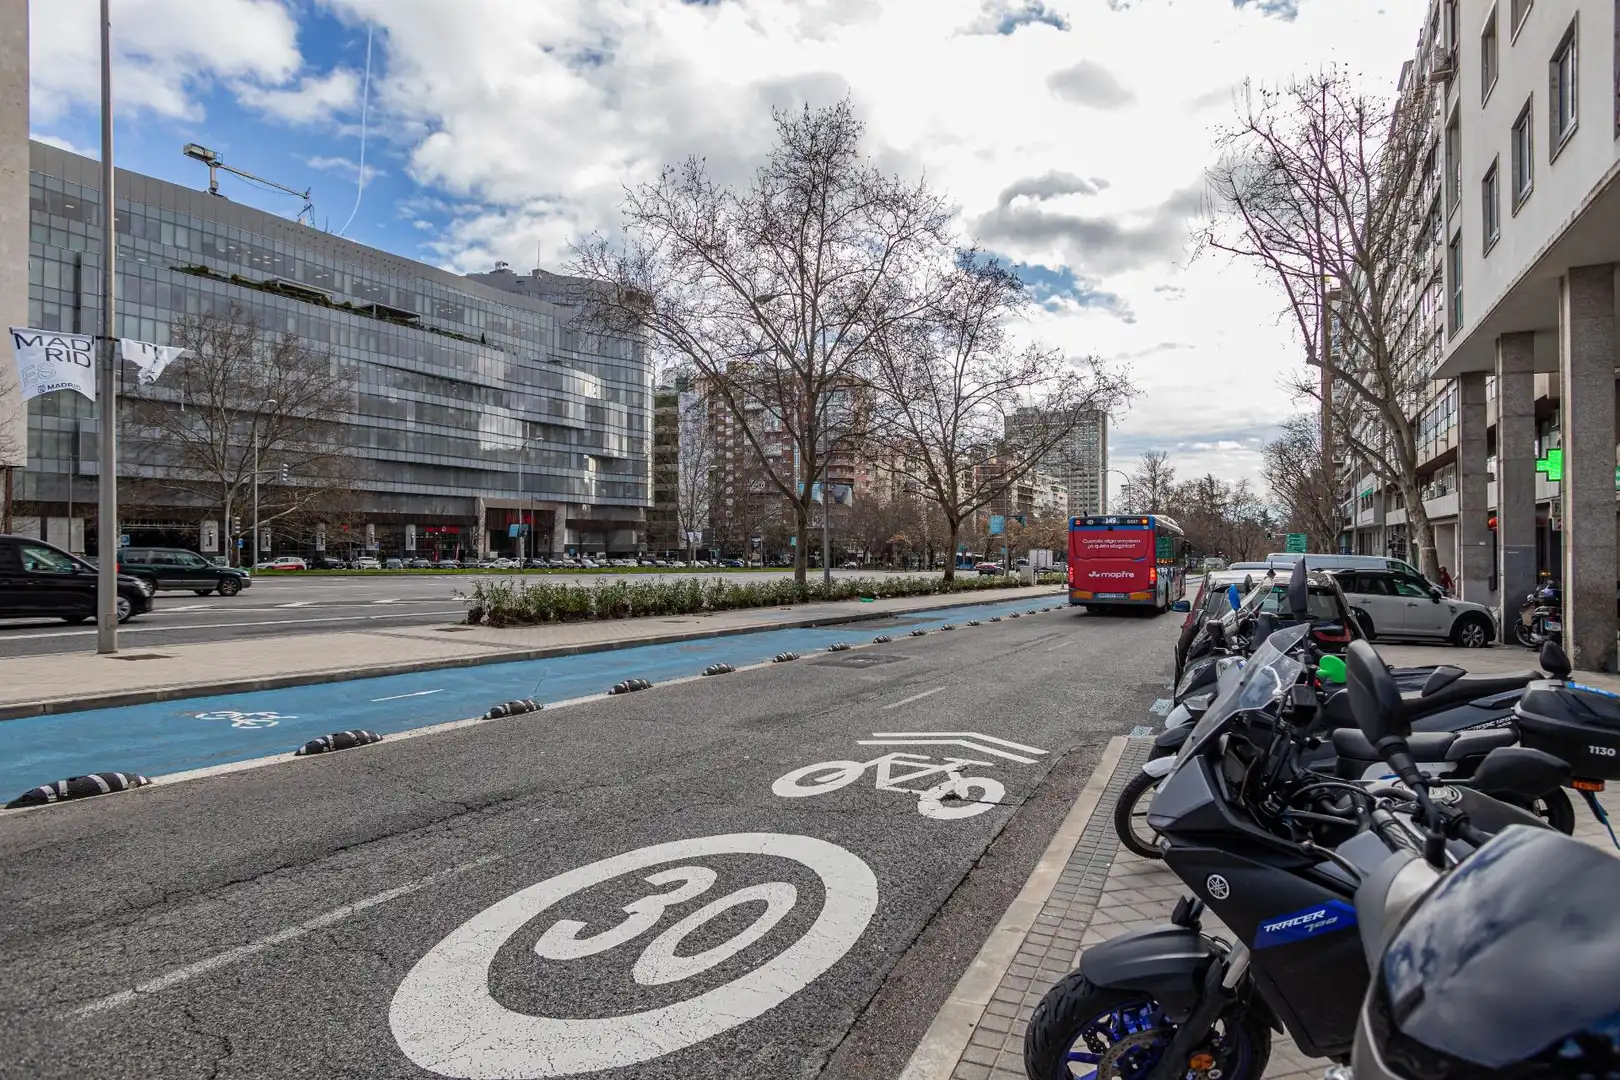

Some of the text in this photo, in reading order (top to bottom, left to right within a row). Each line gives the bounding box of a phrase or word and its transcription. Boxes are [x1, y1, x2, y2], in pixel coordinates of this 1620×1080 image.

[14, 333, 91, 353] MAD
[45, 347, 91, 368] RID
[47, 382, 82, 391] MADRID
[1588, 745, 1616, 757] 1130
[534, 865, 798, 986] 30
[1263, 909, 1326, 933] TRACER
[1303, 916, 1339, 933] 700
